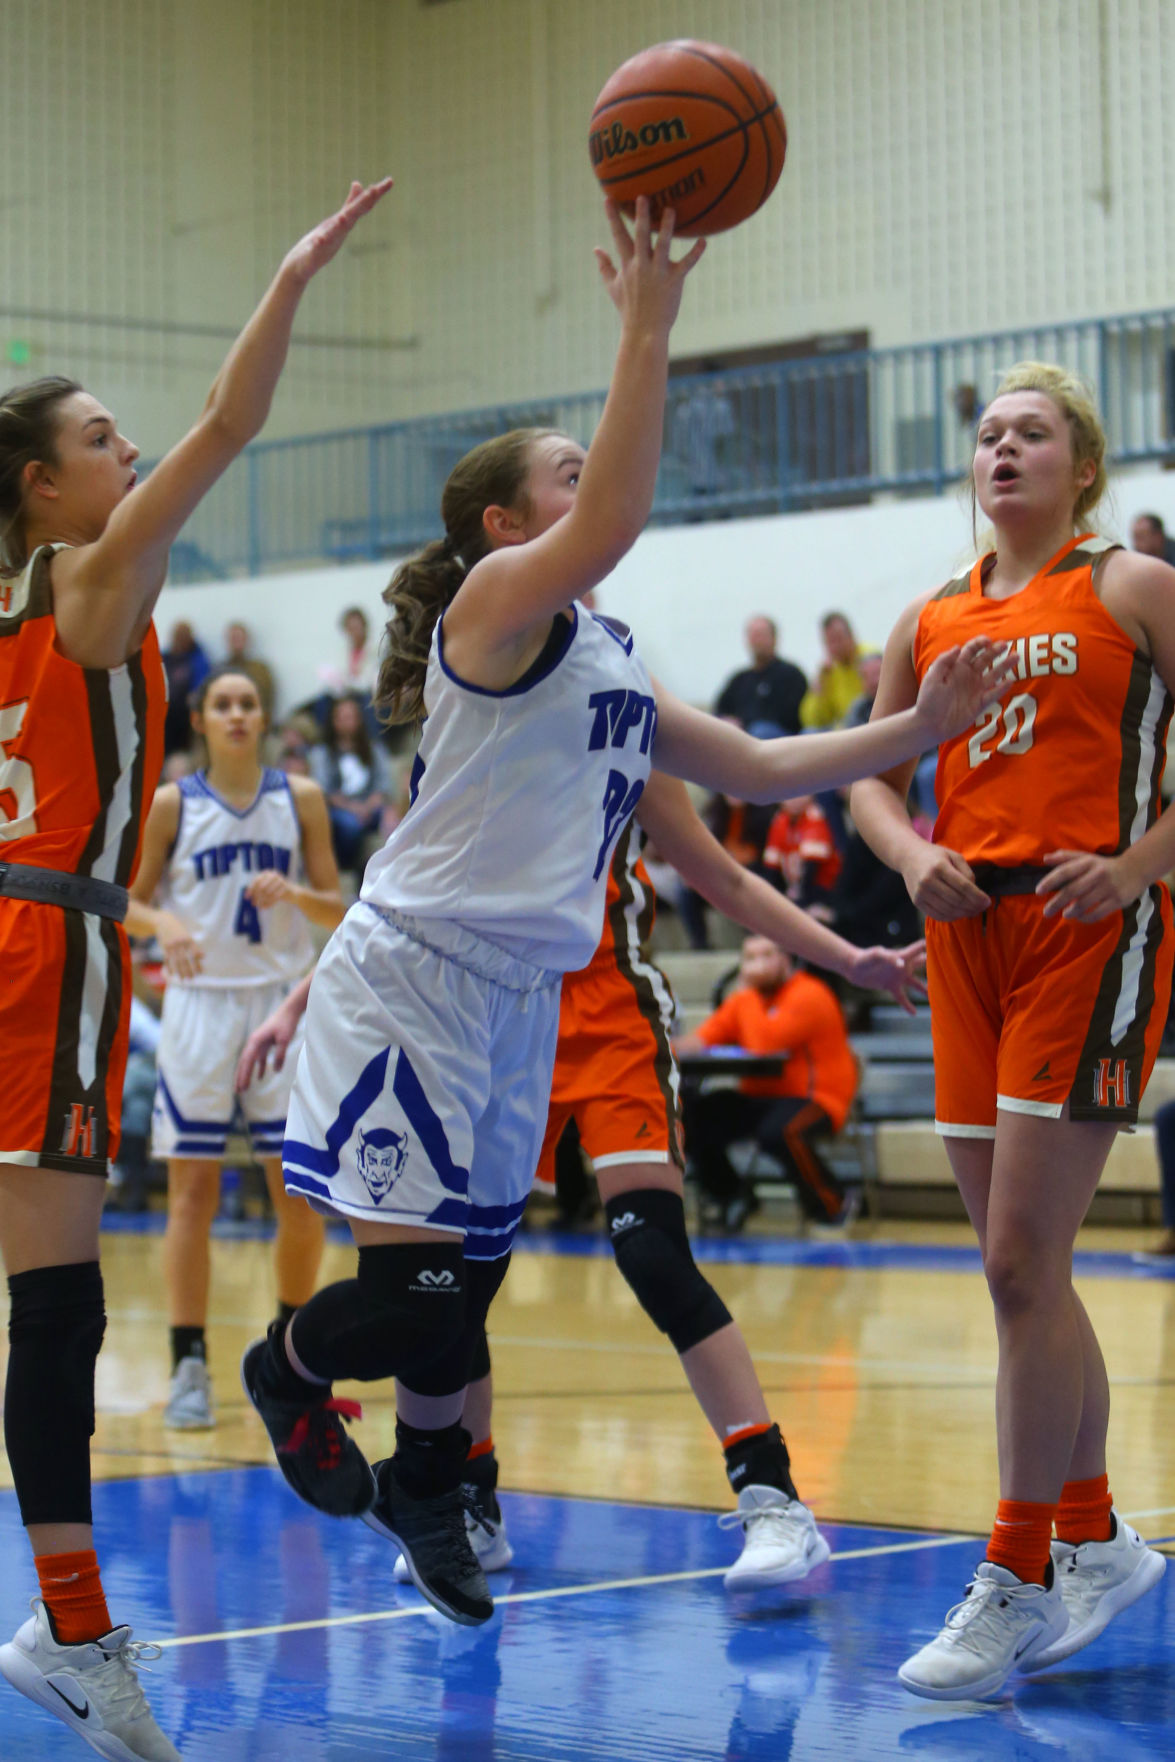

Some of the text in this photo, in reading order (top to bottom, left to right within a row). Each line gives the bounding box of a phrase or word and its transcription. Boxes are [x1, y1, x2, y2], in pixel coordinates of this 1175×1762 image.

[588, 689, 657, 756] TIPT
[968, 692, 1037, 769] 20
[192, 842, 292, 881] TIPTON
[234, 886, 262, 944] 4
